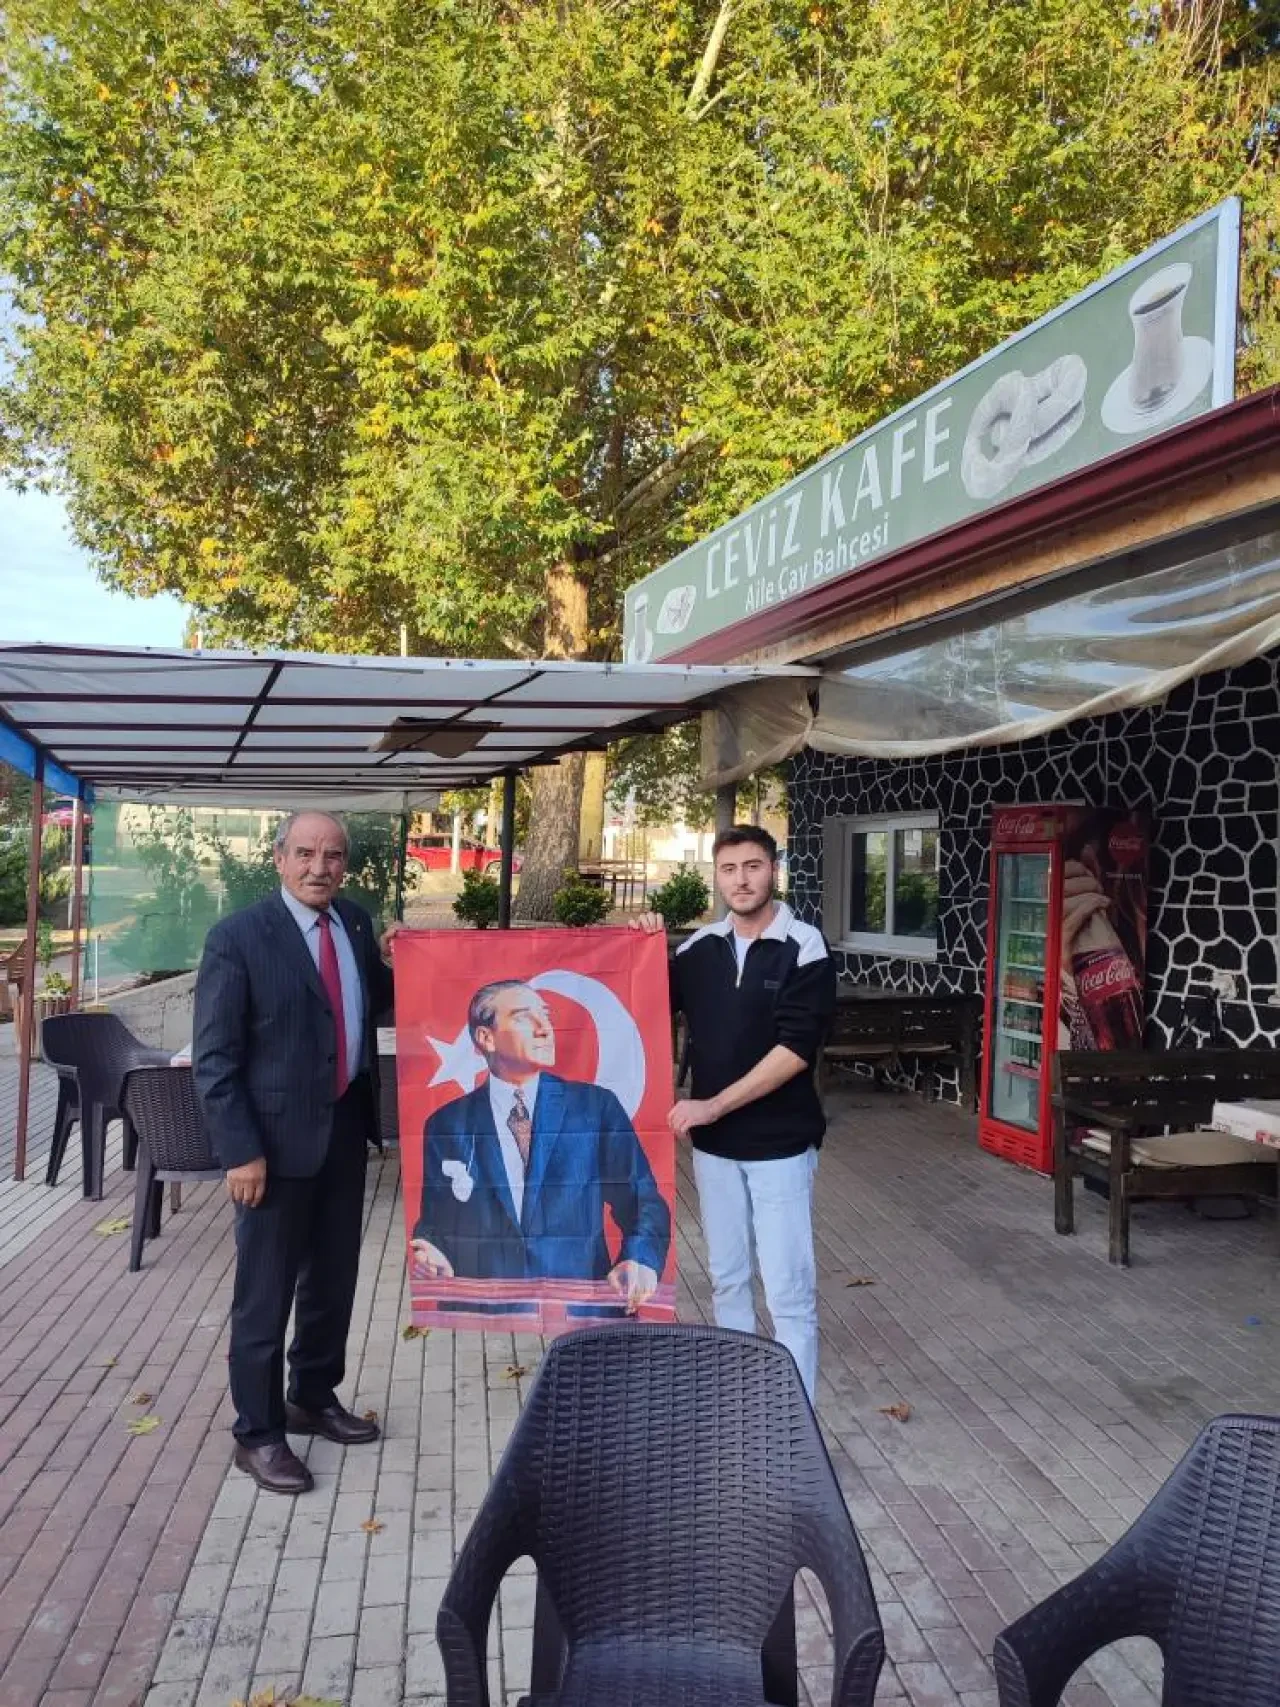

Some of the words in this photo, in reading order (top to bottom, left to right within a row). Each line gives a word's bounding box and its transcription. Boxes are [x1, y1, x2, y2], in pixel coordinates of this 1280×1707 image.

[821, 398, 952, 537] KAFE
[745, 575, 774, 611] Aile
[778, 560, 808, 600] Çay
[813, 512, 889, 578] Bahçesi
